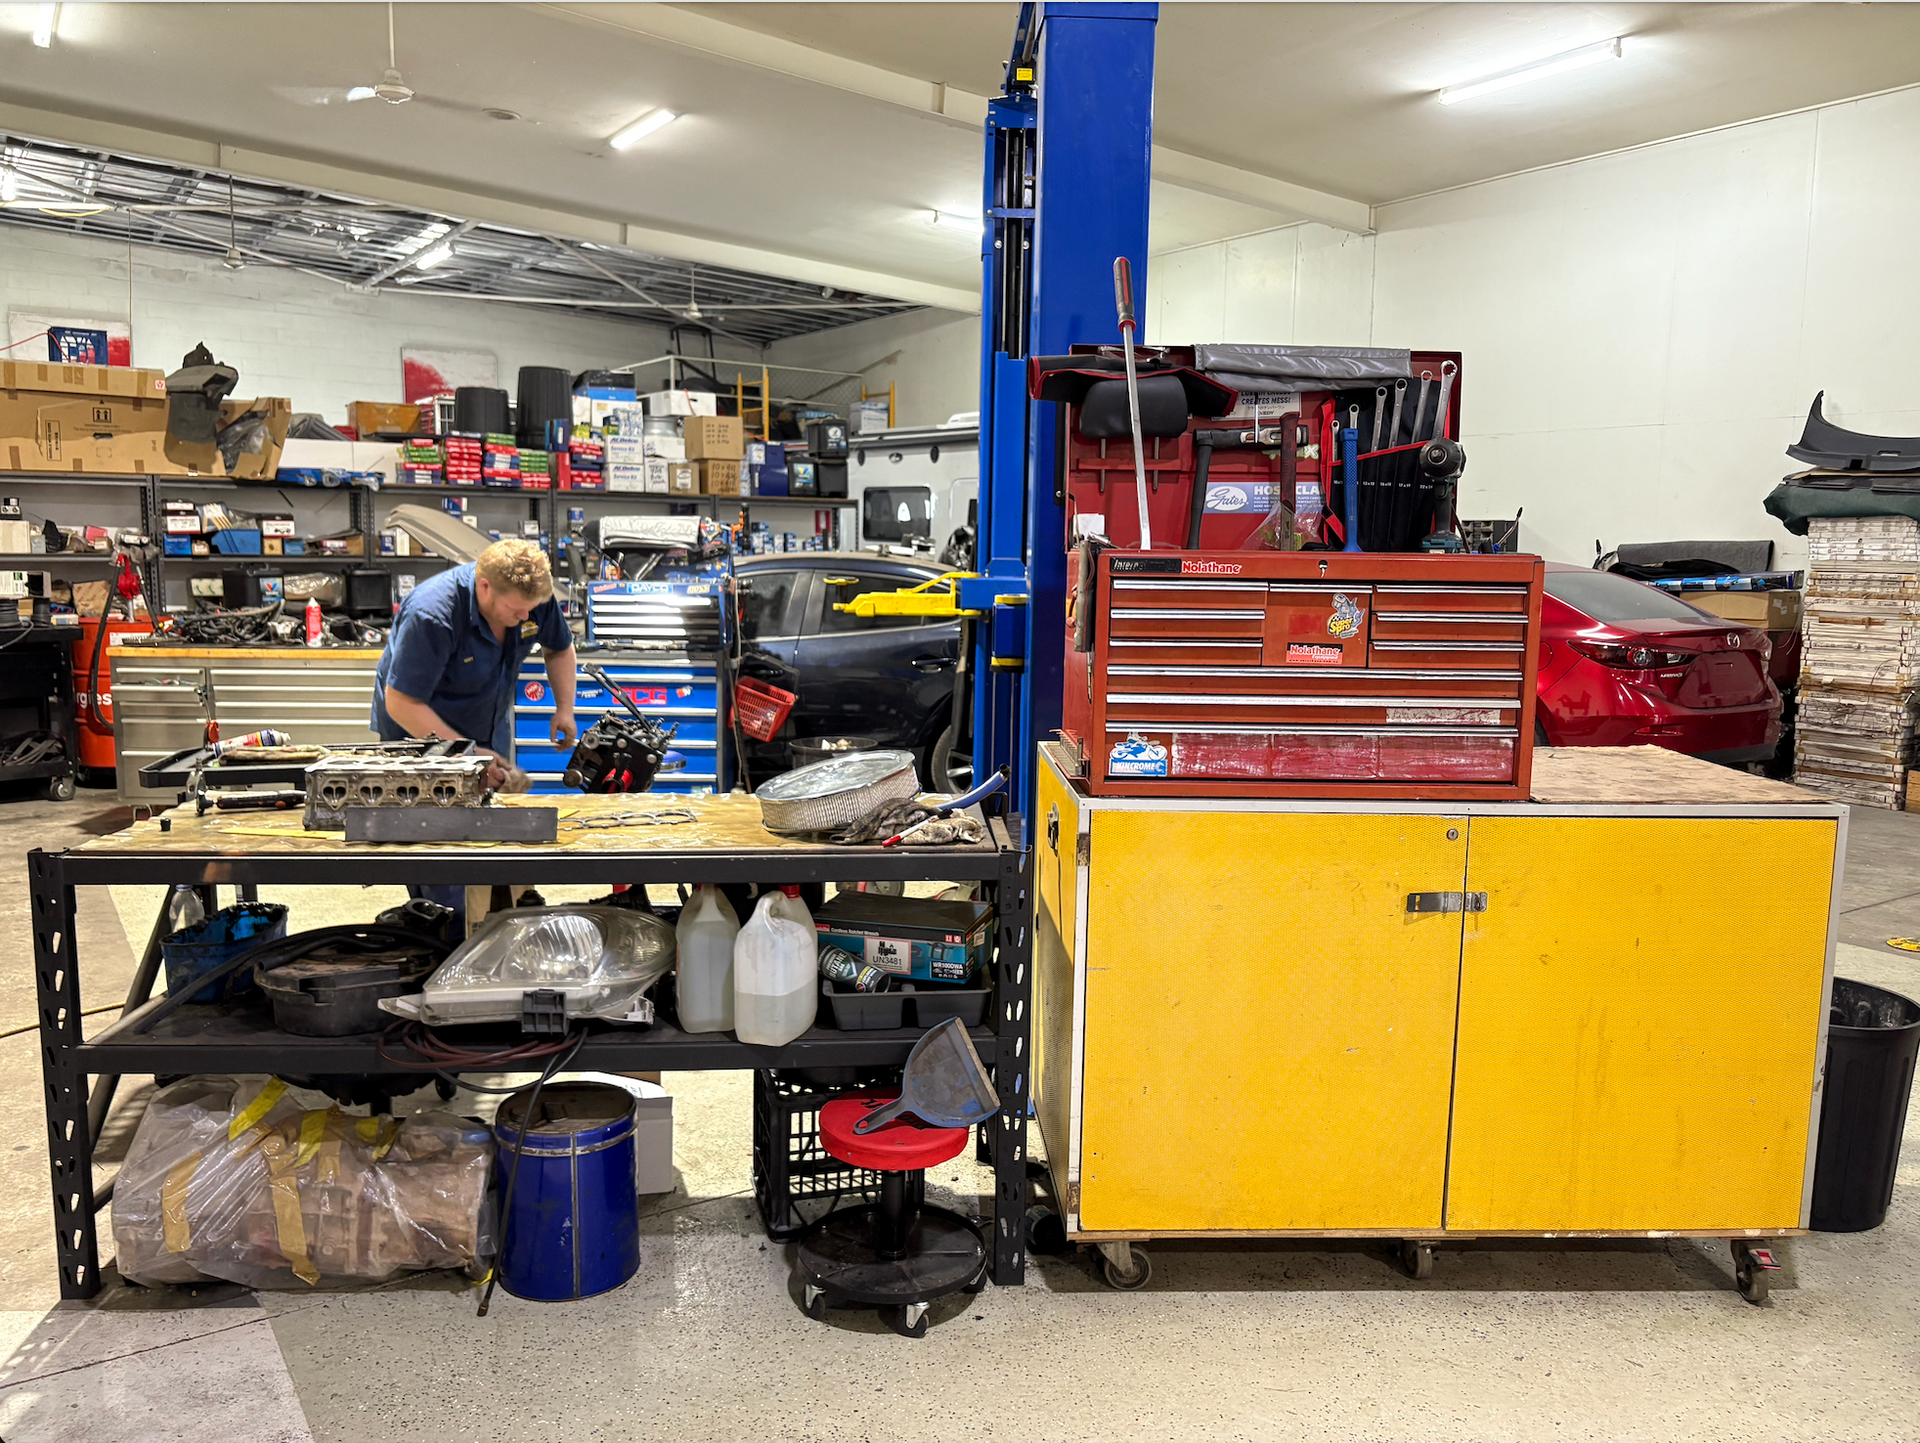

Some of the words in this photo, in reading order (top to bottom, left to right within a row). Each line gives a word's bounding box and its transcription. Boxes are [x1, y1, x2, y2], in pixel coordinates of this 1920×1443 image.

[1254, 485, 1280, 496] HOS
[1296, 485, 1319, 496] CLA
[1206, 488, 1245, 509] Gates
[1182, 561, 1242, 574] Nolathane
[631, 584, 669, 592] DAYCO
[1290, 644, 1341, 655] Nolathane
[1116, 761, 1156, 771] KINCROME
[828, 952, 848, 979] BUTANE
[872, 955, 902, 965] UN3481
